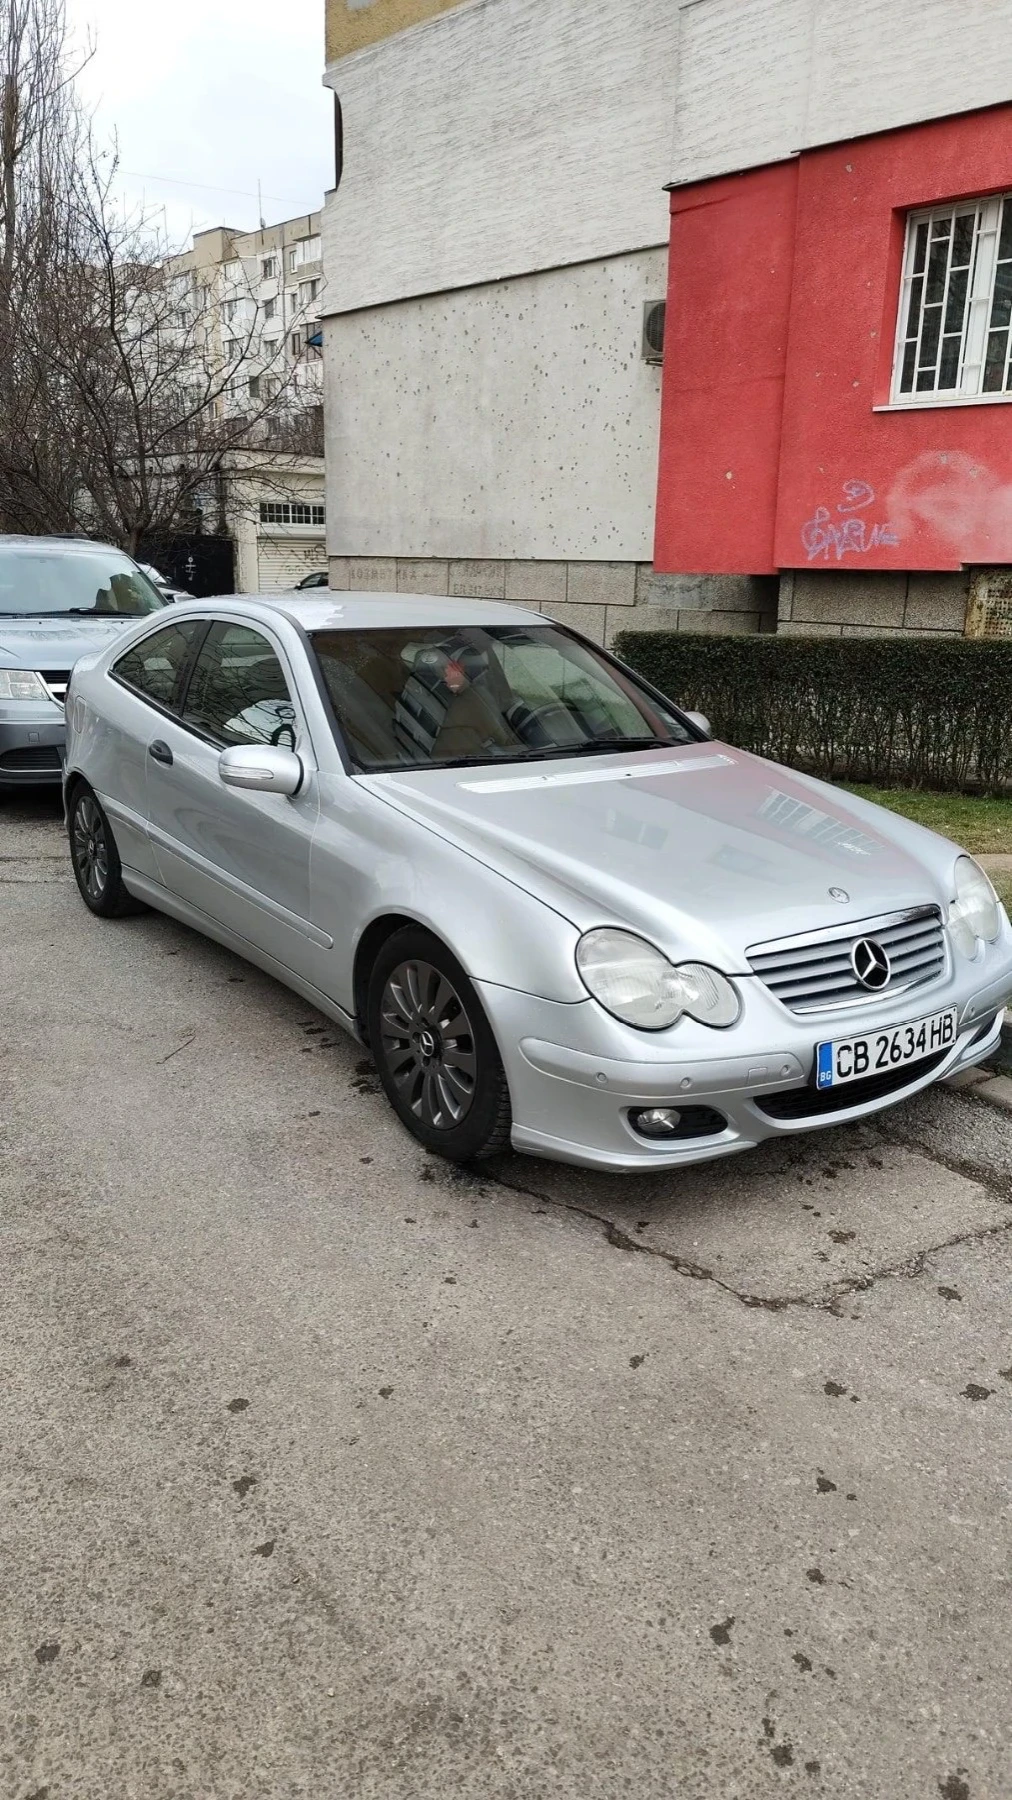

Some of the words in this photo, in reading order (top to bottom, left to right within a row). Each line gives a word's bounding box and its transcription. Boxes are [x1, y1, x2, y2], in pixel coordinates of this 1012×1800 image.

[836, 1040, 870, 1078] CB
[875, 1022, 926, 1069] 2634
[930, 1013, 954, 1050] HB
[820, 1071, 832, 1082] BG
